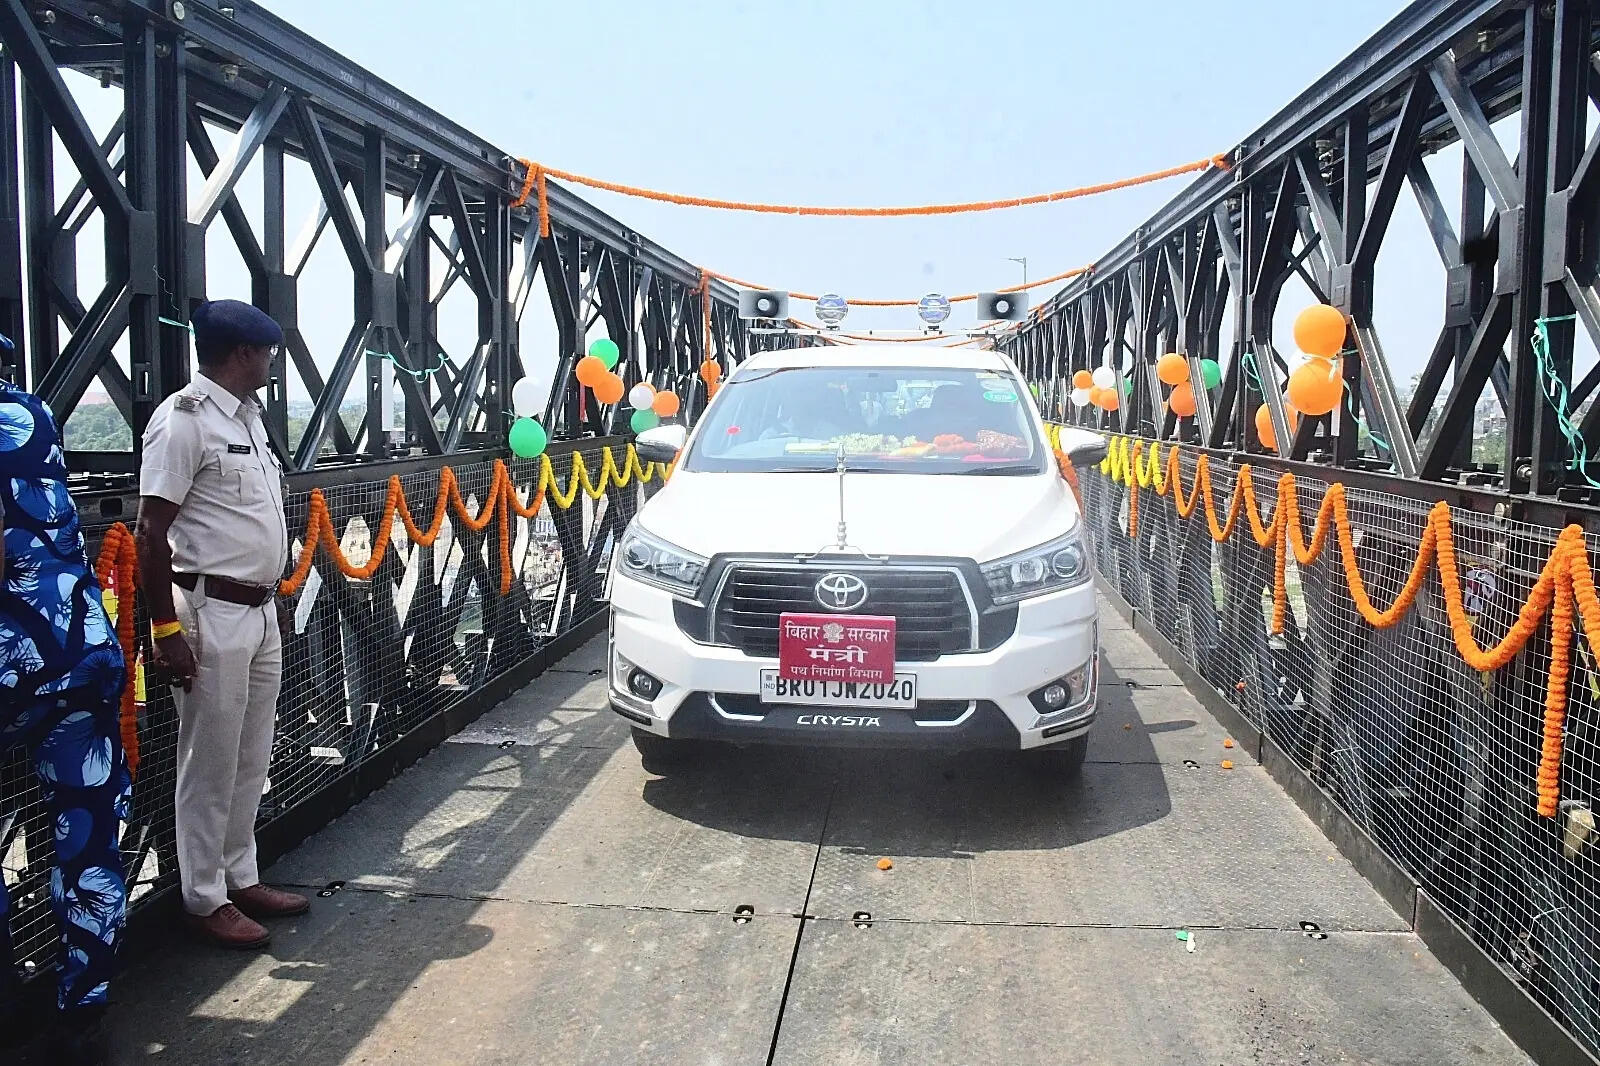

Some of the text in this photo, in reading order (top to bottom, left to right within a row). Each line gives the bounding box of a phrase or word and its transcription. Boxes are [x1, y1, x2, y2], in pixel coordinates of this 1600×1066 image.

[784, 620, 890, 642] बिहार सरकार
[805, 645, 868, 663] मंत्री
[791, 664, 883, 679] पथ निर्माण विभाग
[763, 676, 913, 700] IND BR01JN2040
[797, 715, 880, 726] CRYSTA
